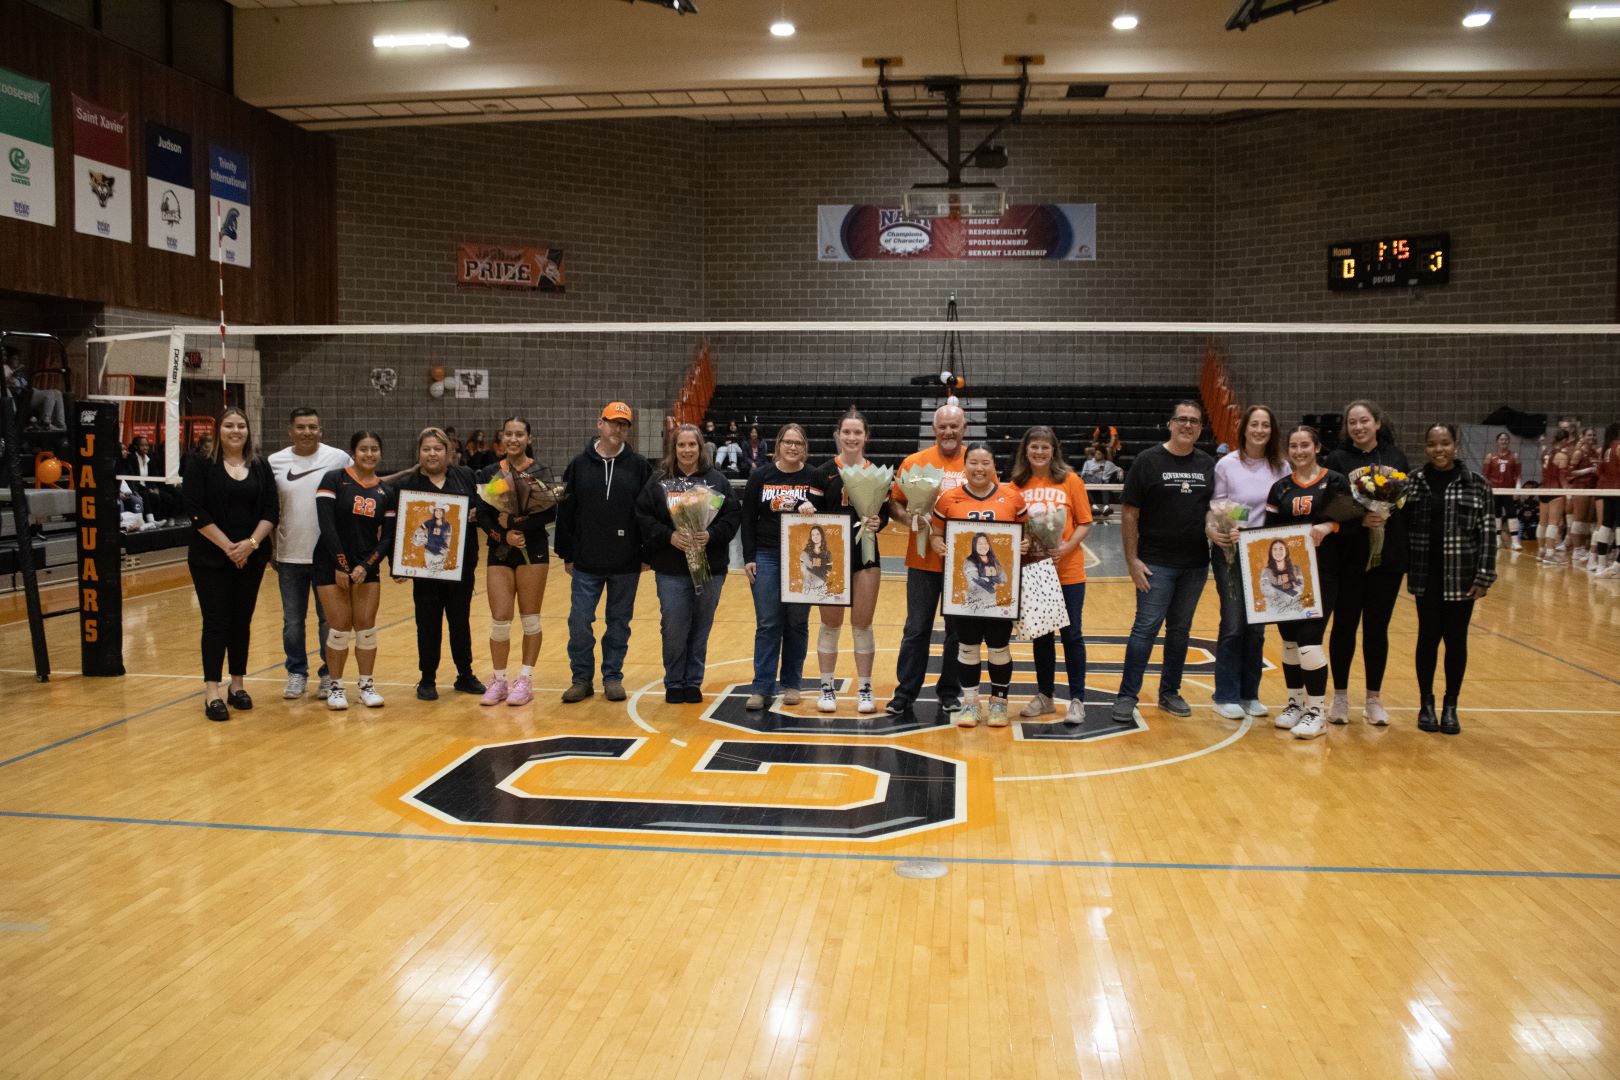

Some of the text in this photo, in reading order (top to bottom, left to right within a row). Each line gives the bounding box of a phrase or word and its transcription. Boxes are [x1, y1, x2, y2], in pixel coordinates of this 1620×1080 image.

[0, 83, 41, 106] oosevelt
[76, 107, 124, 134] Saint Xavier
[158, 136, 183, 154] Judson
[217, 156, 238, 174] Trinity
[210, 168, 247, 190] International
[463, 259, 531, 282] PRIDE
[1162, 472, 1206, 482] GOVERNORS STATE
[761, 488, 808, 502] VOLLEYBALL
[1292, 495, 1313, 516] 15
[352, 495, 376, 518] 22
[80, 434, 100, 643] JAGUARS
